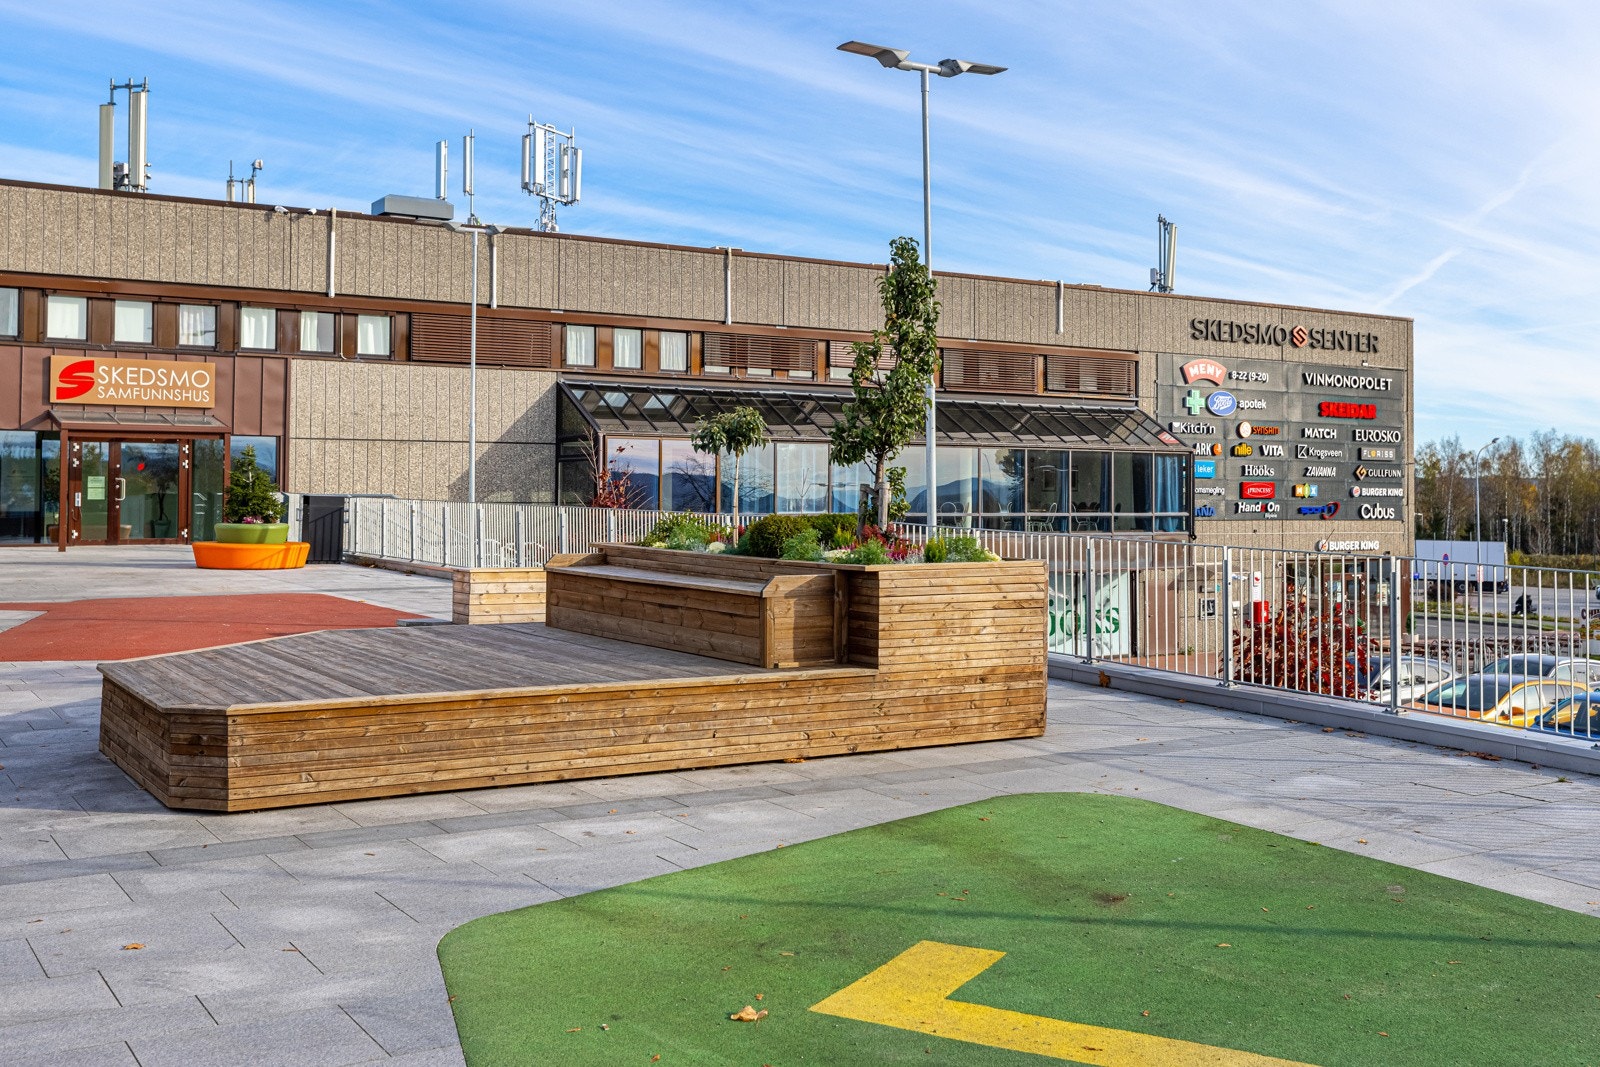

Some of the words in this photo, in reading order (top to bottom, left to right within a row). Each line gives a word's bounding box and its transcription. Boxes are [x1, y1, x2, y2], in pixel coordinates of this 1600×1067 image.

[1191, 317, 1287, 346] SKEDSMO
[1310, 327, 1379, 353] SENTER
[97, 365, 210, 388] SKEDSMO
[1188, 363, 1223, 378] MENY
[1231, 370, 1247, 381] 8-22
[1248, 371, 1269, 383] (9-20)
[1305, 372, 1393, 391] VINMONOPOLET
[97, 385, 210, 402] SAMFUNNSHUS
[1238, 399, 1267, 410] apotek
[1320, 401, 1377, 419] SKEIDAR
[1180, 421, 1216, 434] Kitch'n
[1304, 427, 1337, 439] MATCH
[1355, 429, 1401, 443] EUROSKO
[1234, 443, 1253, 456] nille
[1262, 444, 1284, 457] VITA
[1308, 447, 1343, 460] Krogsveen
[1306, 466, 1337, 477] ZAVANNA
[1368, 469, 1402, 478] GULLFUNN
[1195, 486, 1225, 496] omsmegling
[1361, 487, 1386, 496] BURGER
[1387, 488, 1404, 497] KING
[1361, 503, 1395, 519] Cubus
[1329, 540, 1359, 551] BURGER
[1361, 540, 1380, 551] KING
